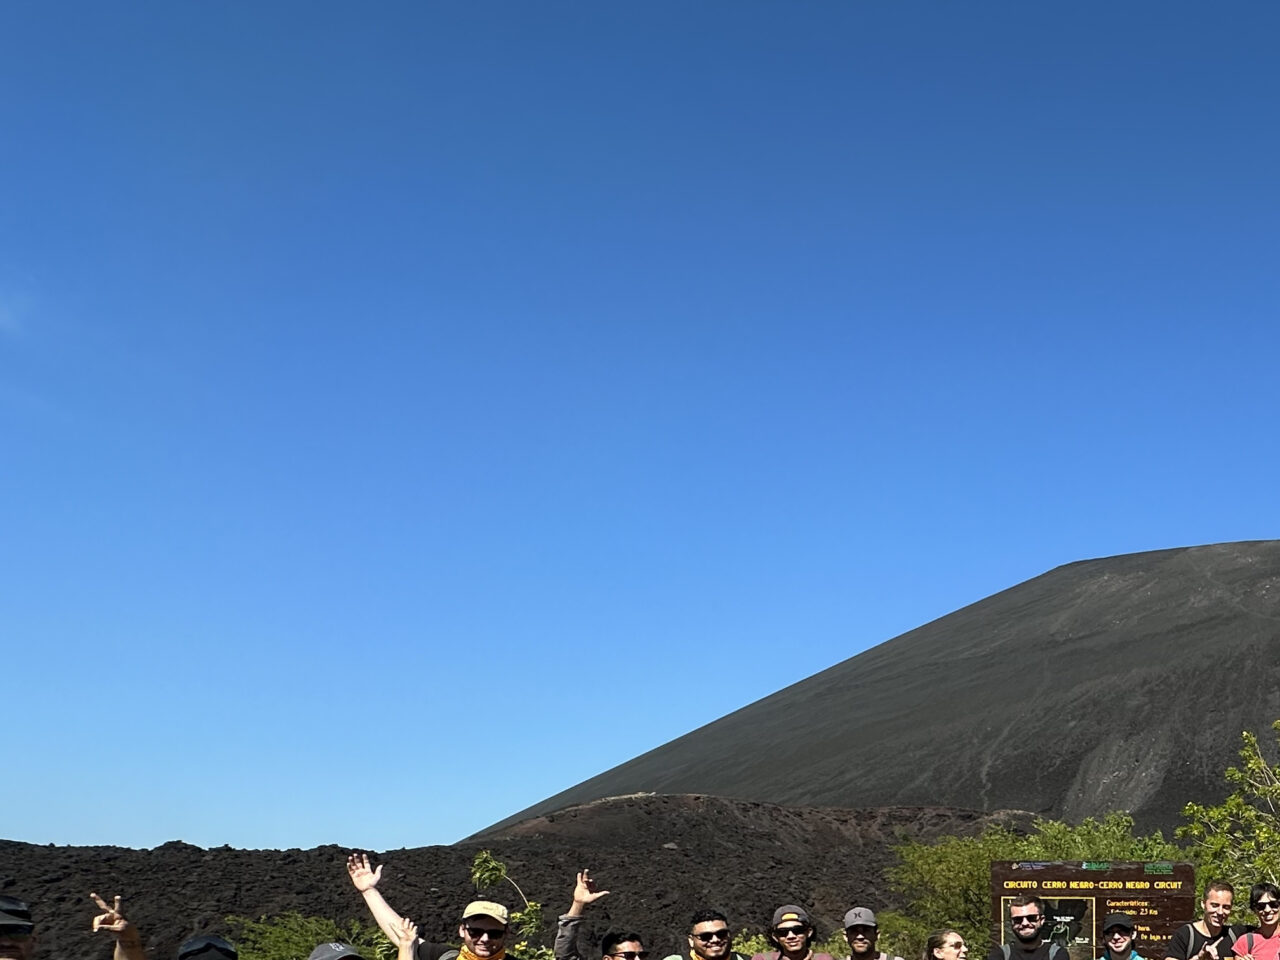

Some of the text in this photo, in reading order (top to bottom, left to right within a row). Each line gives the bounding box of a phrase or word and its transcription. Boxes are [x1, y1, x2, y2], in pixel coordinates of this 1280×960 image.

[1003, 880, 1038, 889] CIRCUITO
[1041, 880, 1067, 889] CERRO
[1125, 881, 1151, 889] NEGRO
[1153, 881, 1183, 889] CIRCUIT
